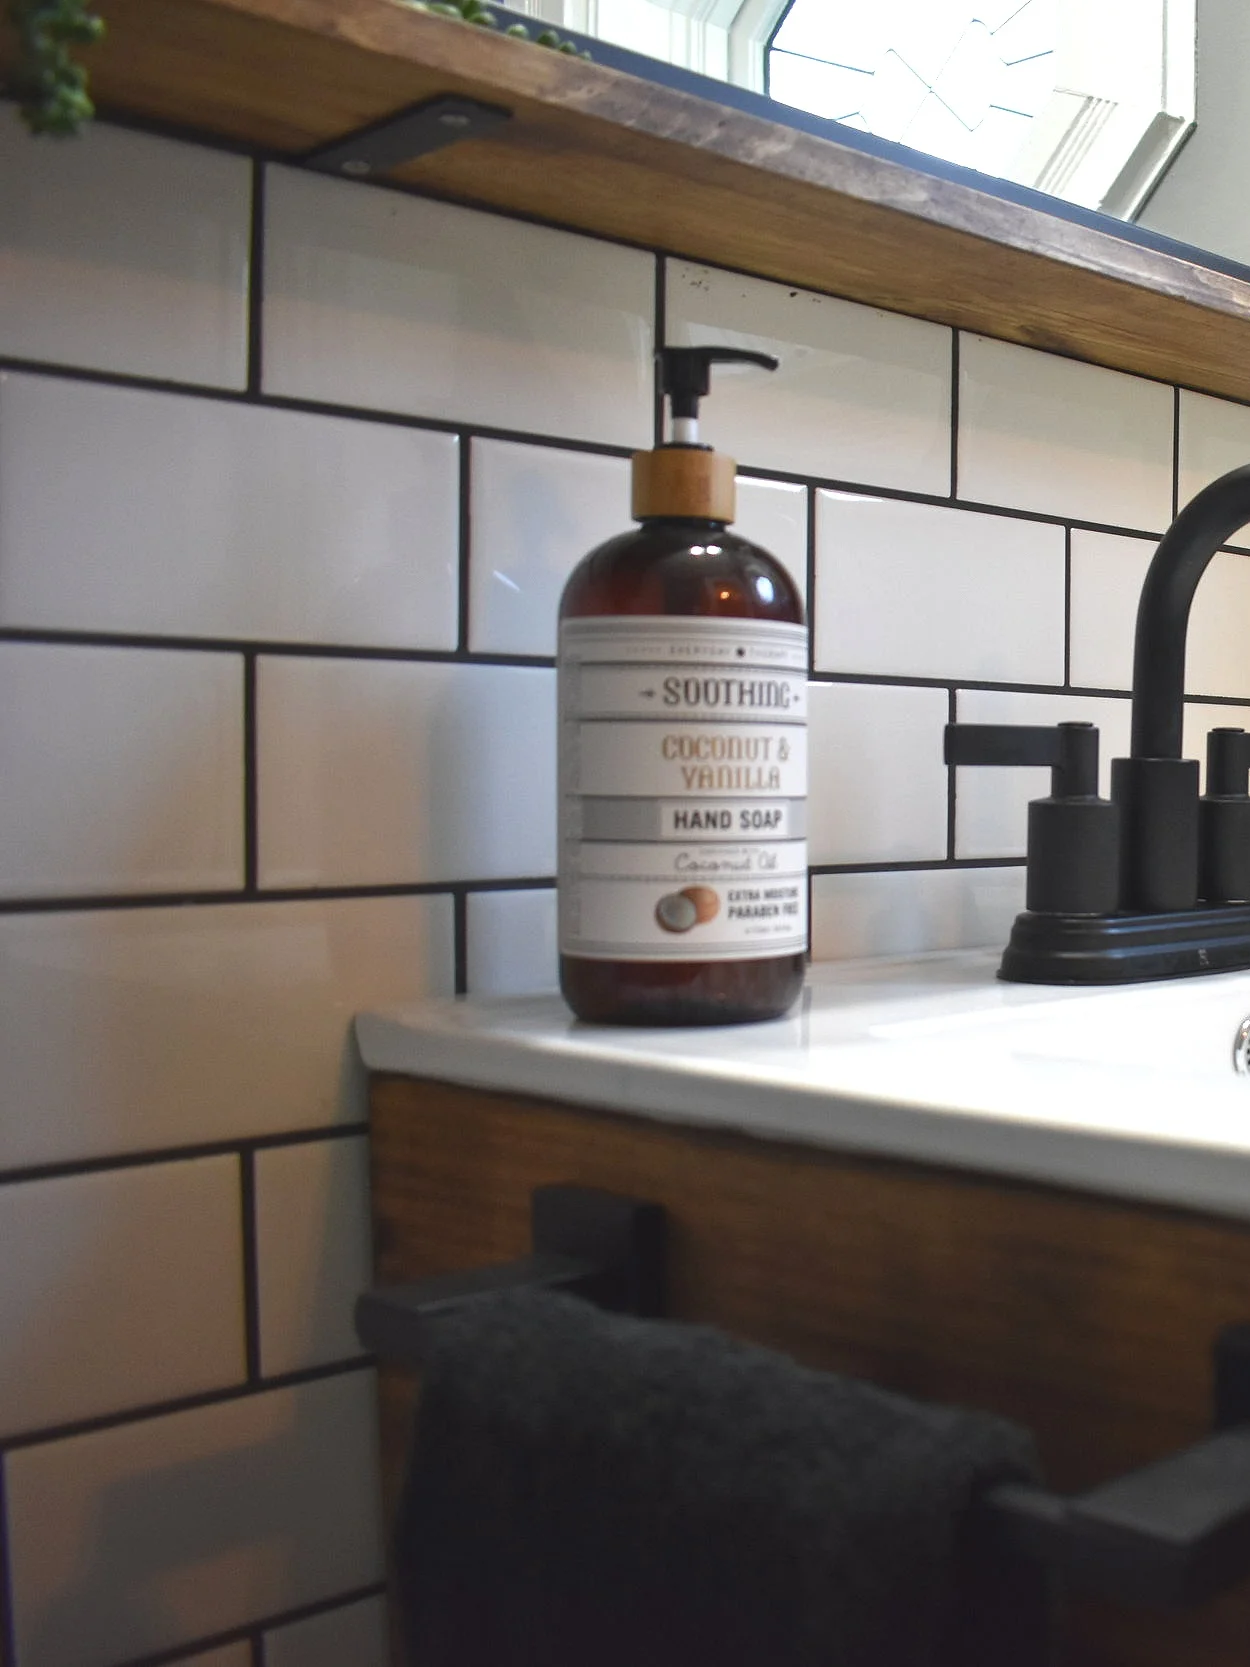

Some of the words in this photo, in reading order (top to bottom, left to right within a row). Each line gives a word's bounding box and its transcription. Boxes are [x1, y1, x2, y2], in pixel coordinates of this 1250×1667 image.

[662, 676, 790, 709] SOOTHING
[661, 734, 774, 761] COCONUT
[778, 737, 791, 762] &
[681, 766, 781, 791] VANILLA
[674, 809, 732, 830] HAND
[740, 810, 783, 829] SOAP
